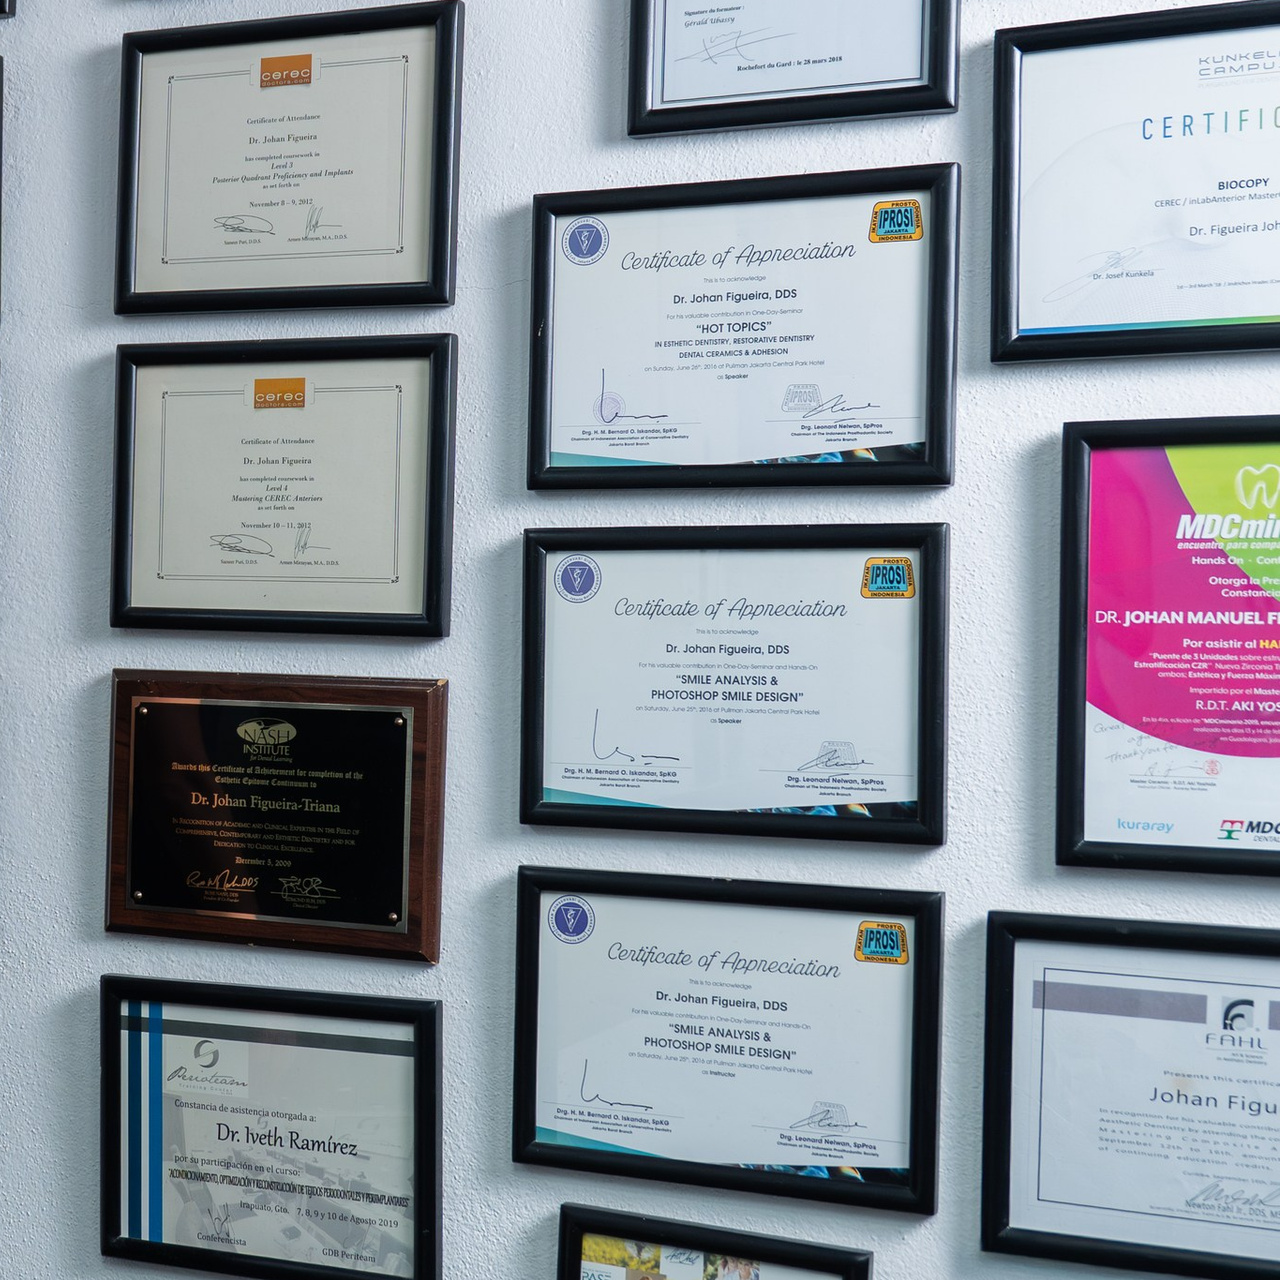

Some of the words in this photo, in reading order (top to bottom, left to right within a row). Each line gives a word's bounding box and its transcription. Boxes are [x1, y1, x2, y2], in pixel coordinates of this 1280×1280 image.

[261, 68, 310, 81] cerec
[262, 134, 285, 144] Johan
[287, 133, 318, 143] Figueira
[1218, 178, 1270, 190] BIOCOPY
[879, 208, 914, 229] IPROSI
[1189, 226, 1207, 236] Dr.
[1210, 222, 1258, 237] Figueira
[878, 234, 913, 242] INDONESIA
[621, 251, 707, 273] Certificate
[712, 245, 734, 269] of
[735, 242, 856, 268] Appreciation
[1093, 272, 1104, 280] Dr.
[1106, 271, 1123, 279] Josef
[1126, 269, 1154, 278] Kunkela
[673, 294, 687, 304] Dr.
[690, 292, 724, 303] Johan
[726, 290, 772, 303] Figueira,
[775, 289, 797, 298] DDS
[255, 391, 304, 401] cerec
[870, 564, 905, 585] IPROSI
[614, 597, 699, 620] Certificate
[704, 599, 725, 619] of
[727, 598, 847, 620] Appreciation
[1096, 611, 1121, 623] DR.
[1124, 611, 1184, 624] JOHAN
[1187, 611, 1264, 625] MANUEL
[715, 675, 767, 686] ANALYSIS
[770, 676, 779, 686] &
[651, 690, 719, 701] PHOTOSHOP
[721, 691, 753, 701] SMILE
[243, 728, 290, 744] NASH
[243, 744, 290, 756] INSTITUTE
[191, 792, 209, 806] Dr.
[212, 794, 247, 808] Johan
[250, 796, 340, 813] Figueira-Triana
[1118, 818, 1174, 834] kuraray
[864, 928, 899, 950] IPROSI
[608, 942, 693, 968] Certificate
[698, 949, 719, 971] of
[721, 952, 840, 979] Appreciation
[1206, 1033, 1268, 1050] FAHL
[1150, 1087, 1218, 1108] Johan
[217, 1123, 240, 1143] Dr.
[246, 1126, 284, 1148] Iveth
[288, 1130, 358, 1156] Ramírez
[197, 1232, 247, 1247] Conferencista
